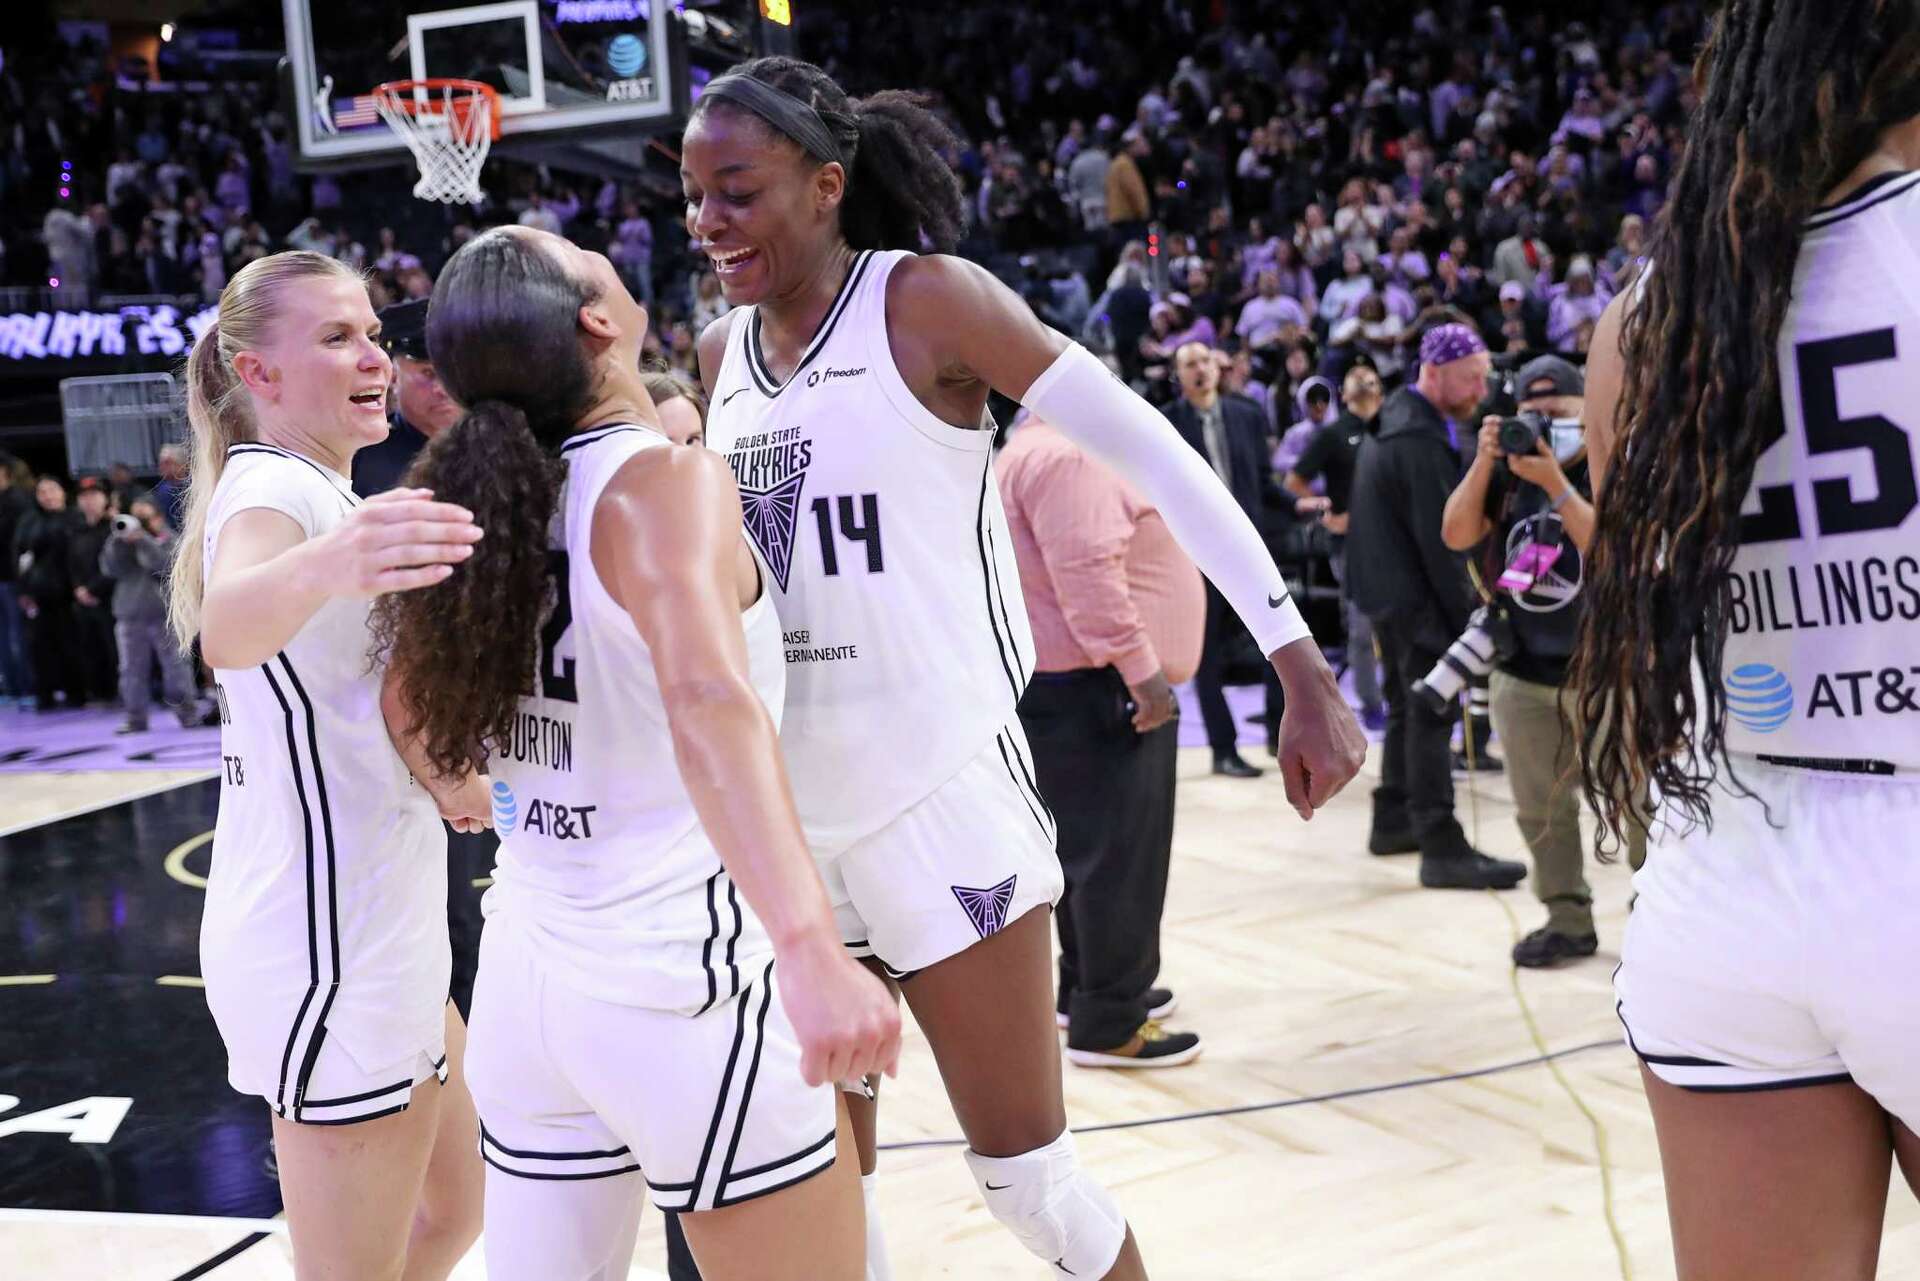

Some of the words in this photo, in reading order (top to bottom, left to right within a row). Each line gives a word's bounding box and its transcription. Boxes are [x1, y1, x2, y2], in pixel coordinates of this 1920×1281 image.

[607, 77, 653, 102] AT&T
[823, 366, 867, 383] freedom
[734, 433, 769, 450] GOLDEN
[771, 425, 801, 444] STATE
[810, 493, 884, 577] 14
[1728, 556, 1920, 634] BILLINGS
[783, 630, 809, 645] AISER
[785, 645, 858, 663] ERMANENTE
[1806, 666, 1920, 719] AT&
[524, 798, 597, 840] AT&T
